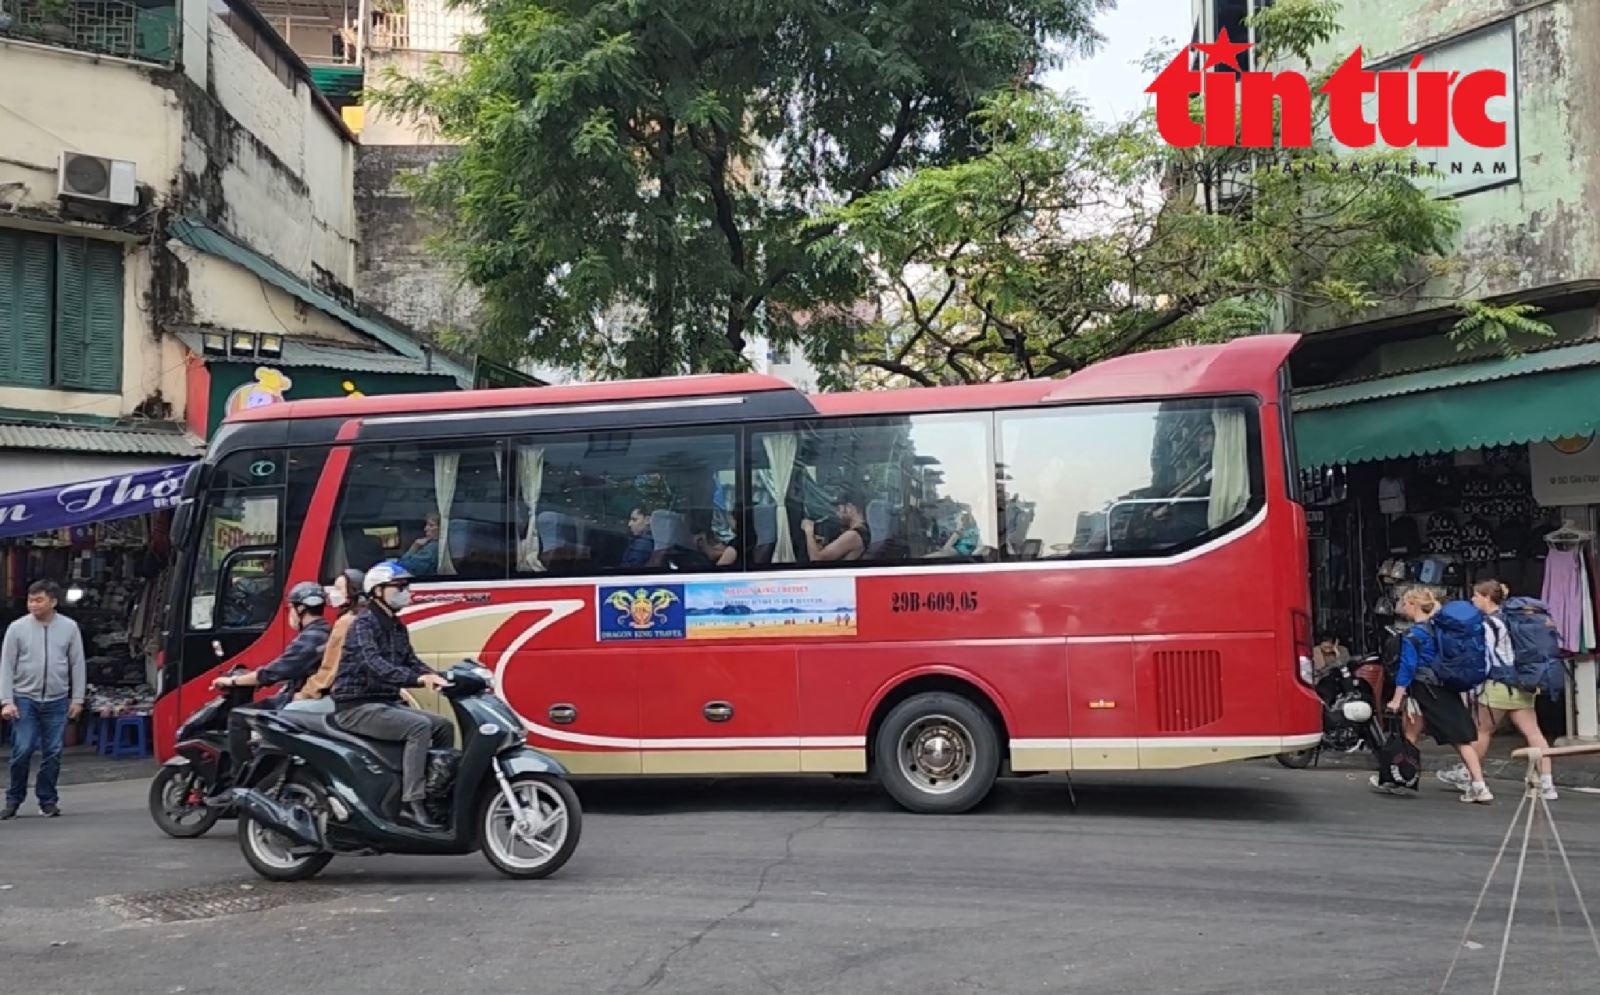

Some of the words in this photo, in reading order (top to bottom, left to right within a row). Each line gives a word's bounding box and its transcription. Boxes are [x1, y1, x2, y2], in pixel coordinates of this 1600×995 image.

[891, 591, 978, 613] 29B-609.05
[634, 630, 653, 638] KING
[654, 629, 683, 638] TRAVEL
